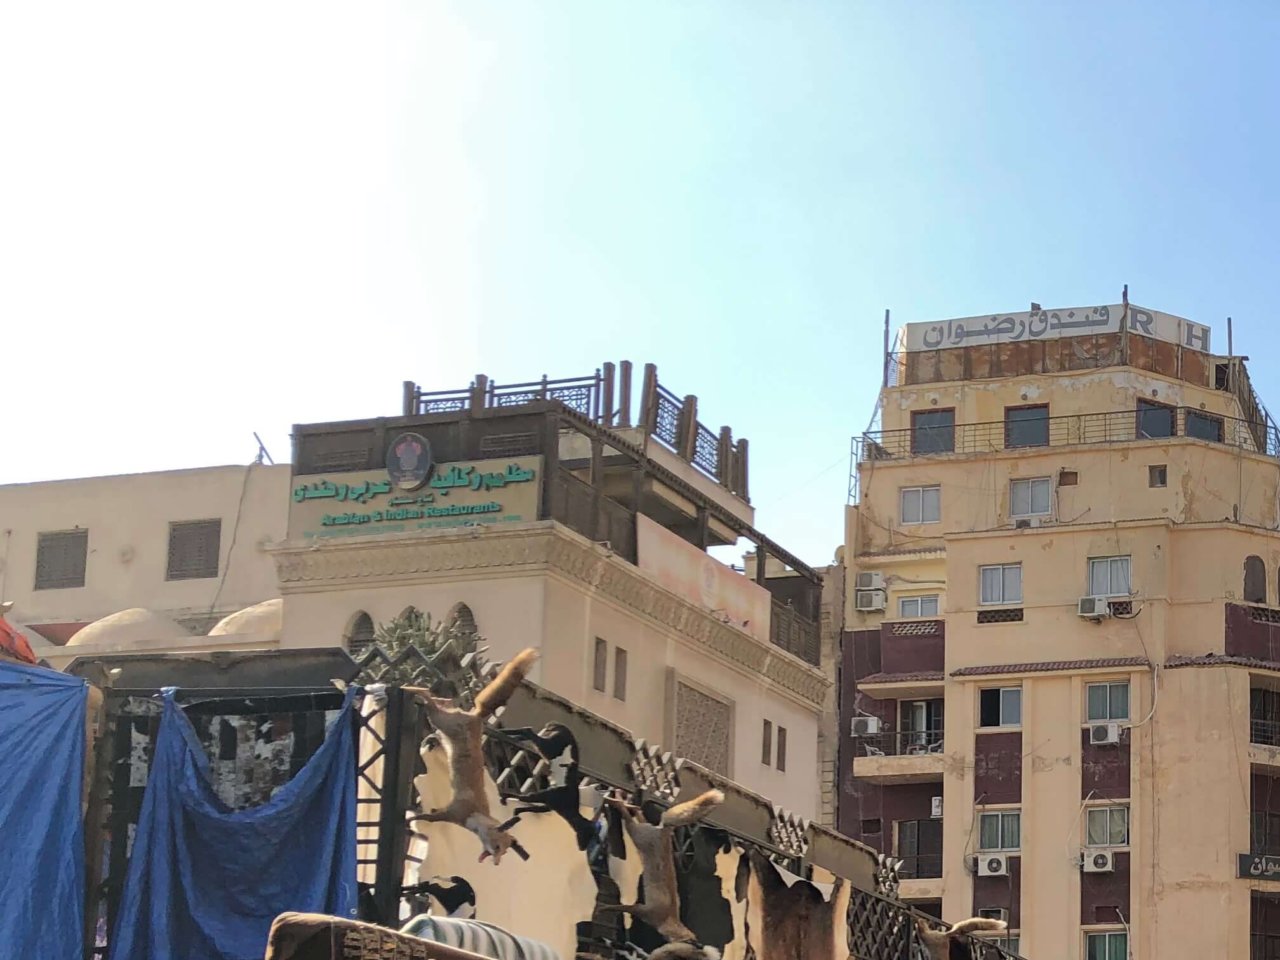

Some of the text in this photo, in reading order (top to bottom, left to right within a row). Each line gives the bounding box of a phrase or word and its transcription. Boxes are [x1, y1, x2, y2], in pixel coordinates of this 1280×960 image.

[923, 305, 1111, 348] فندق رضوان
[1129, 307, 1209, 352] R H
[371, 510, 383, 522] &
[384, 507, 421, 522] Indian
